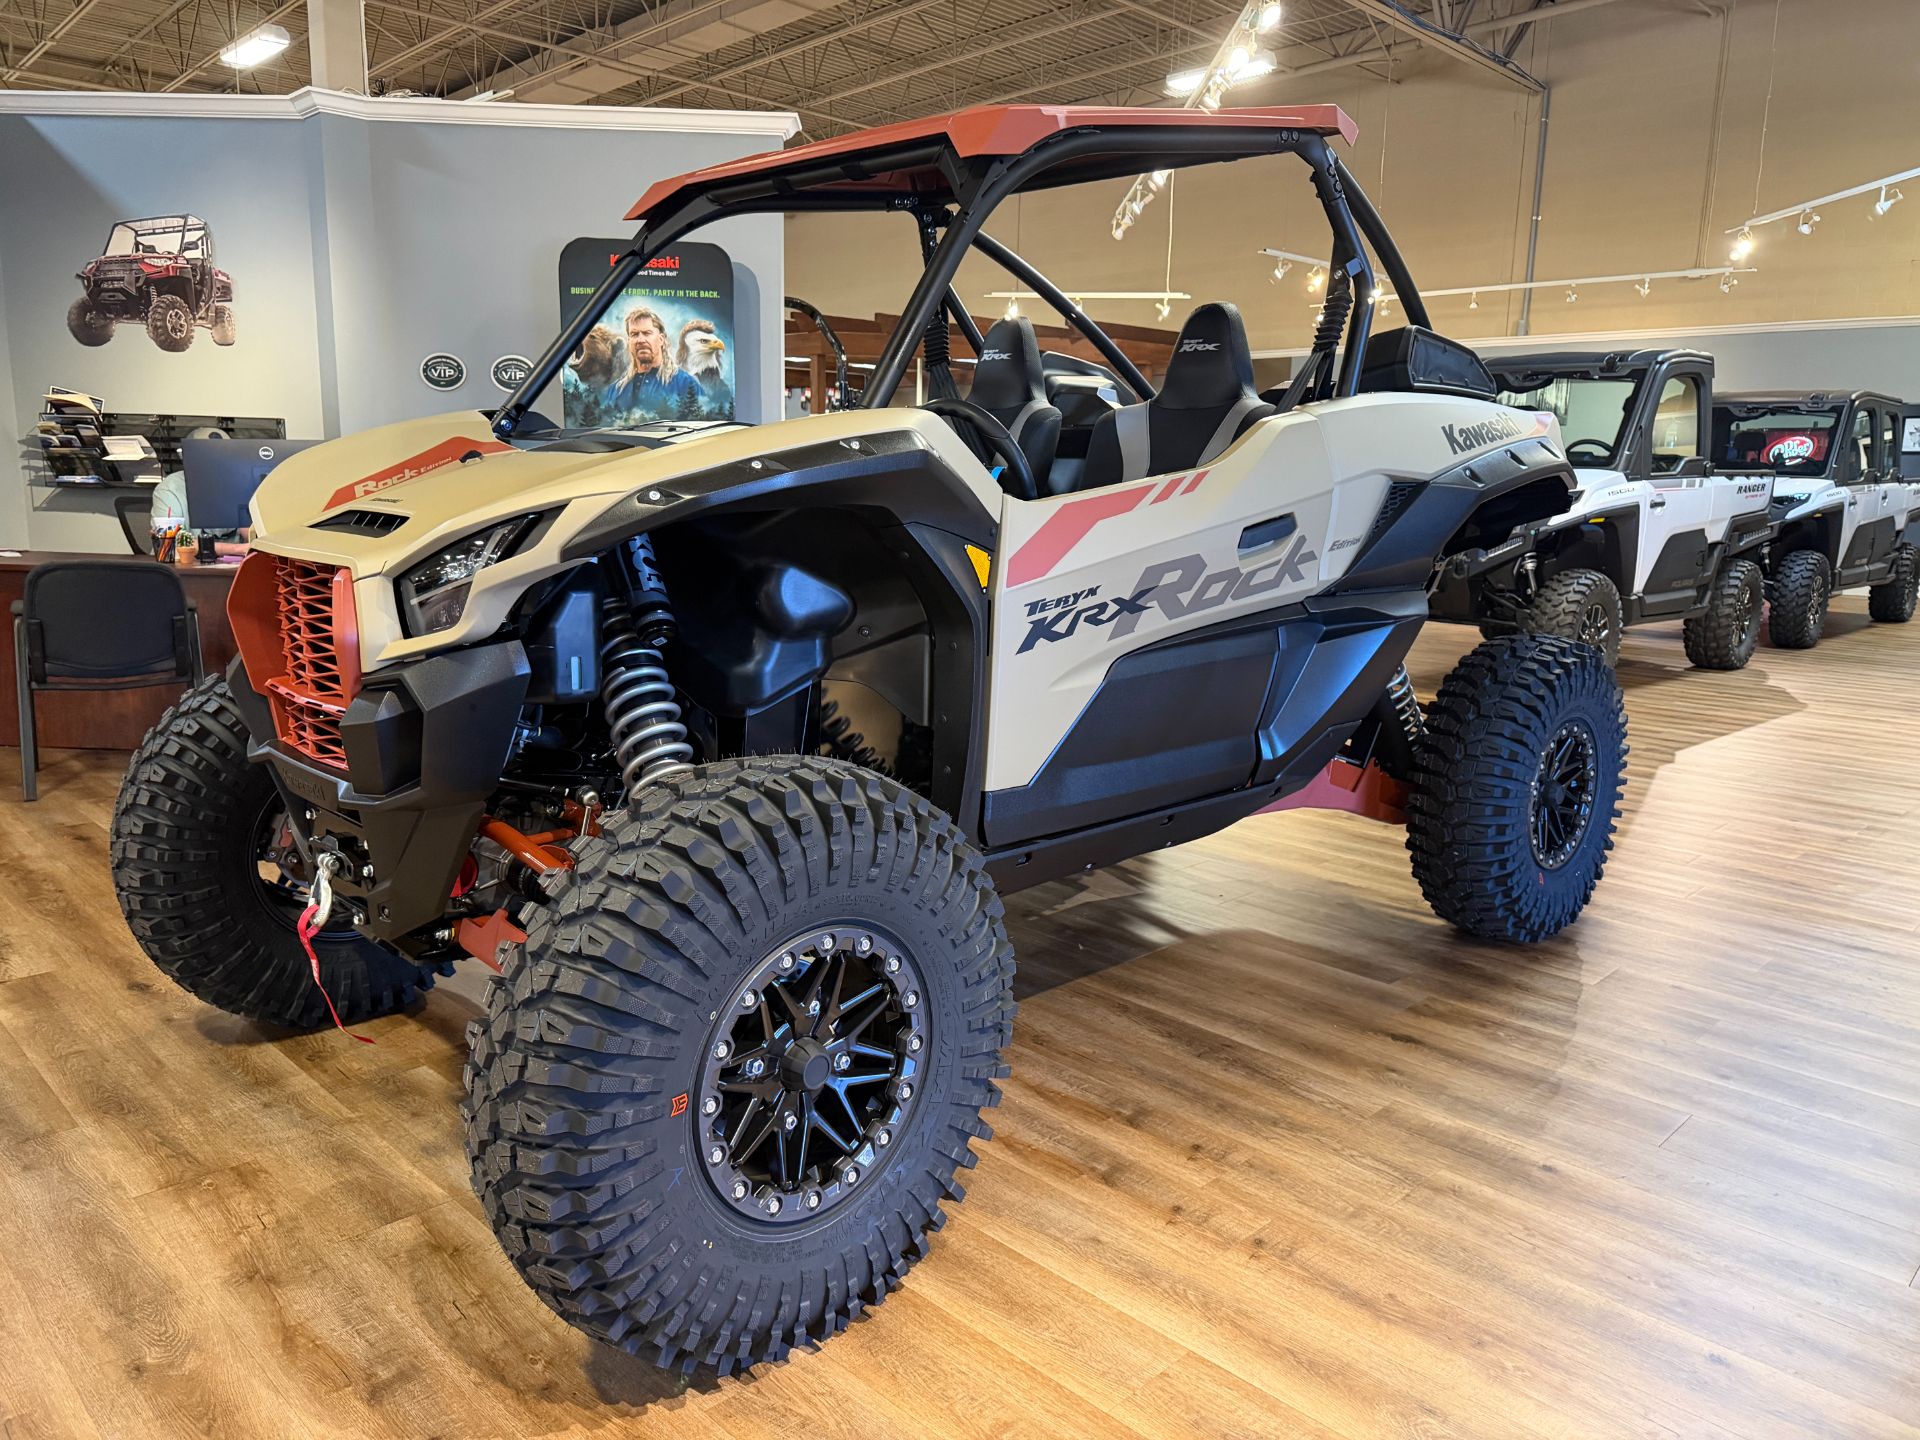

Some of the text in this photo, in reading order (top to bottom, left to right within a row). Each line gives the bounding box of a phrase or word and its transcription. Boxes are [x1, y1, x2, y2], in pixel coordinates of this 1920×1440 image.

[654, 289, 675, 297] PARTY
[700, 290, 720, 298] BACK.
[1178, 343, 1222, 353] KRX
[979, 353, 1013, 362] KRX
[431, 368, 455, 378] VIP
[501, 370, 525, 380] VIP
[1441, 411, 1522, 455] Kawasaki
[353, 468, 418, 498] Rock
[1736, 483, 1767, 495] RANGER
[1107, 535, 1363, 641] Rock Edition
[1015, 584, 1160, 656] KRX
